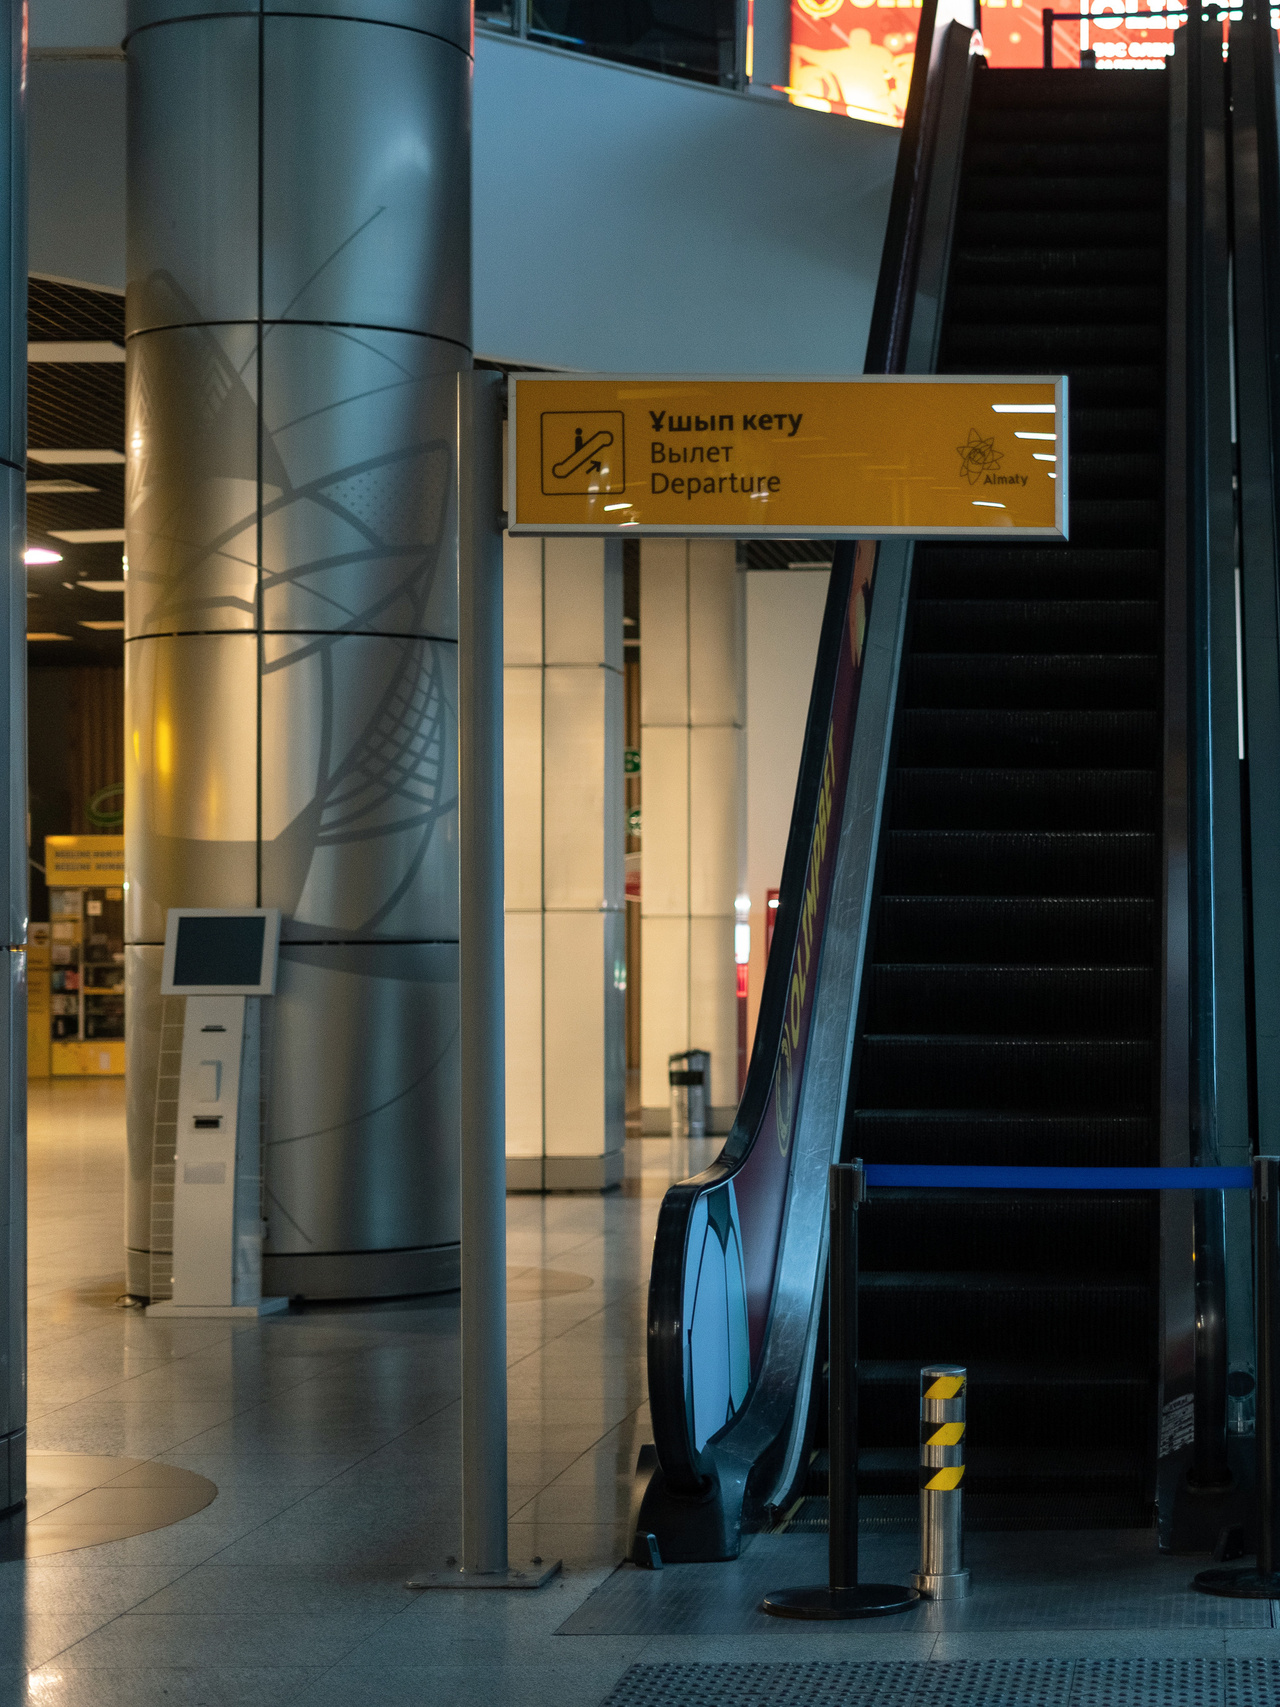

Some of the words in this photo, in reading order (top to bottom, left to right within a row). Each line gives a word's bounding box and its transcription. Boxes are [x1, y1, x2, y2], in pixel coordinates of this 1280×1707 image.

[649, 411, 734, 432] Ұшып
[743, 413, 803, 437] кету
[651, 442, 733, 463] Вылет
[651, 473, 781, 500] Departure
[983, 473, 1028, 487] Almaty
[791, 720, 835, 1049] OLIMPBET
